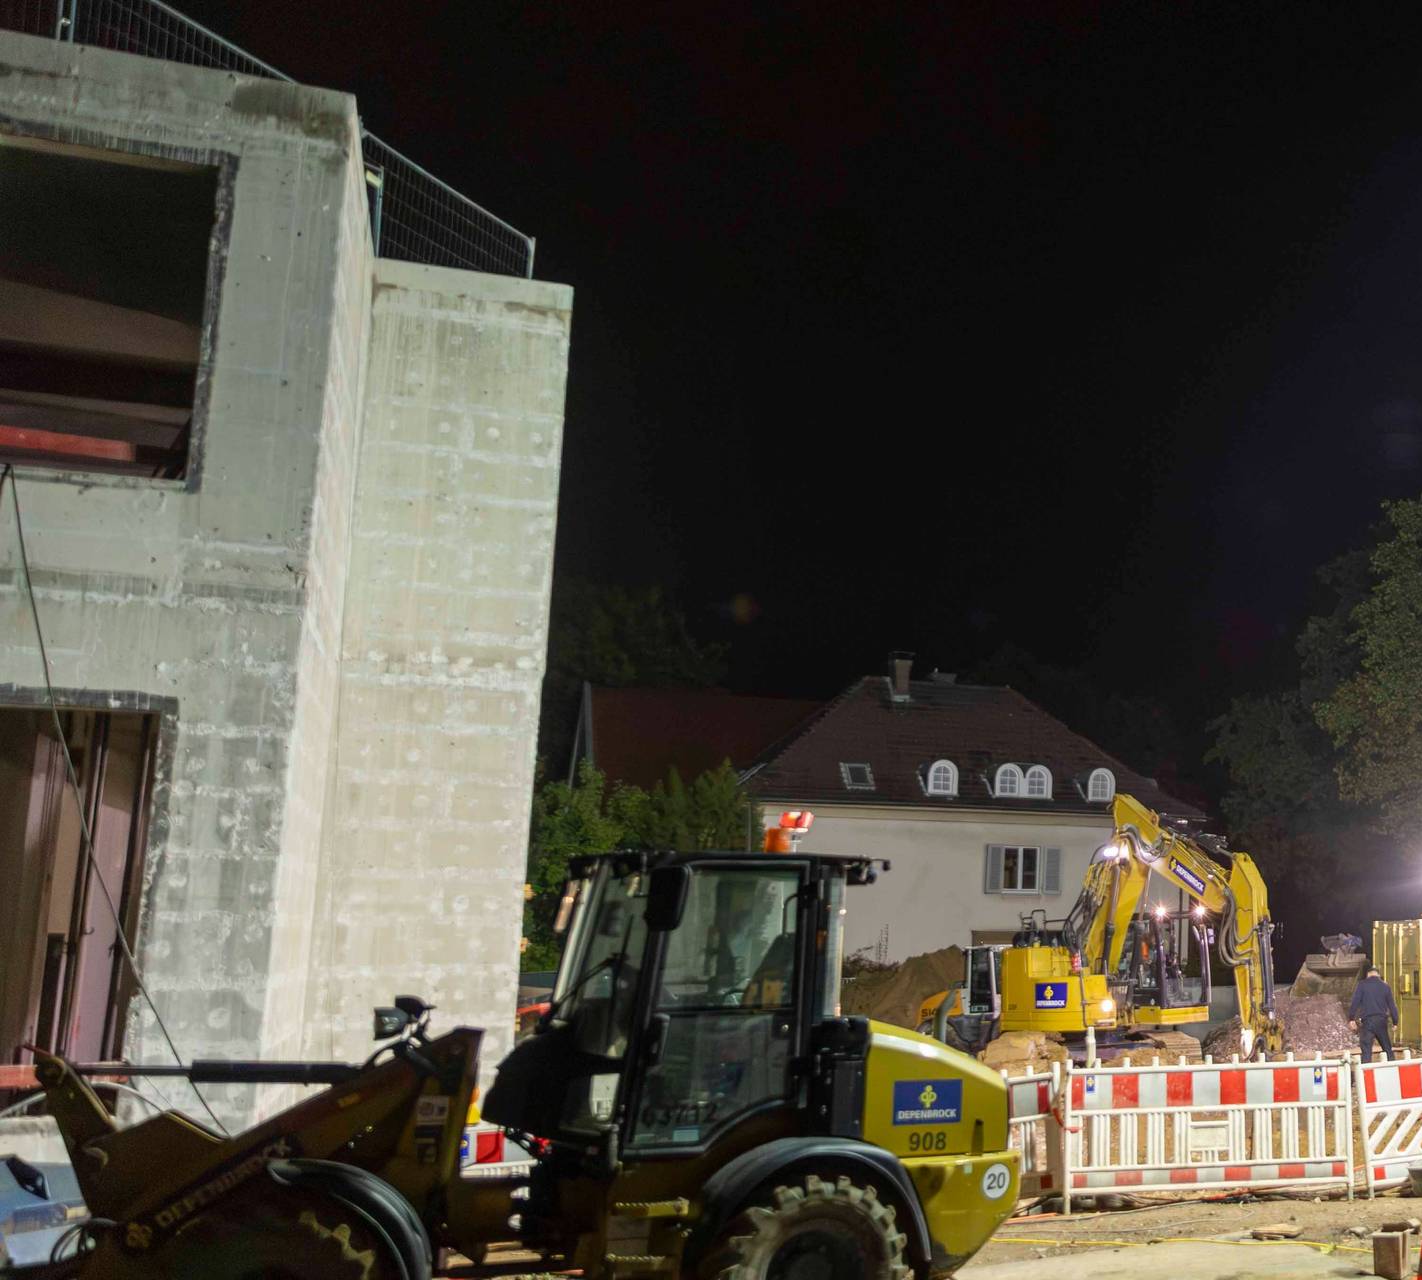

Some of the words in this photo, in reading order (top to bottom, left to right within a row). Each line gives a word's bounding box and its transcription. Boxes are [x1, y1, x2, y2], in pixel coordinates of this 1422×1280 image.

[898, 1109, 957, 1120] DEPENBROCK
[909, 1132, 946, 1151] 908
[986, 1172, 1006, 1191] 20
